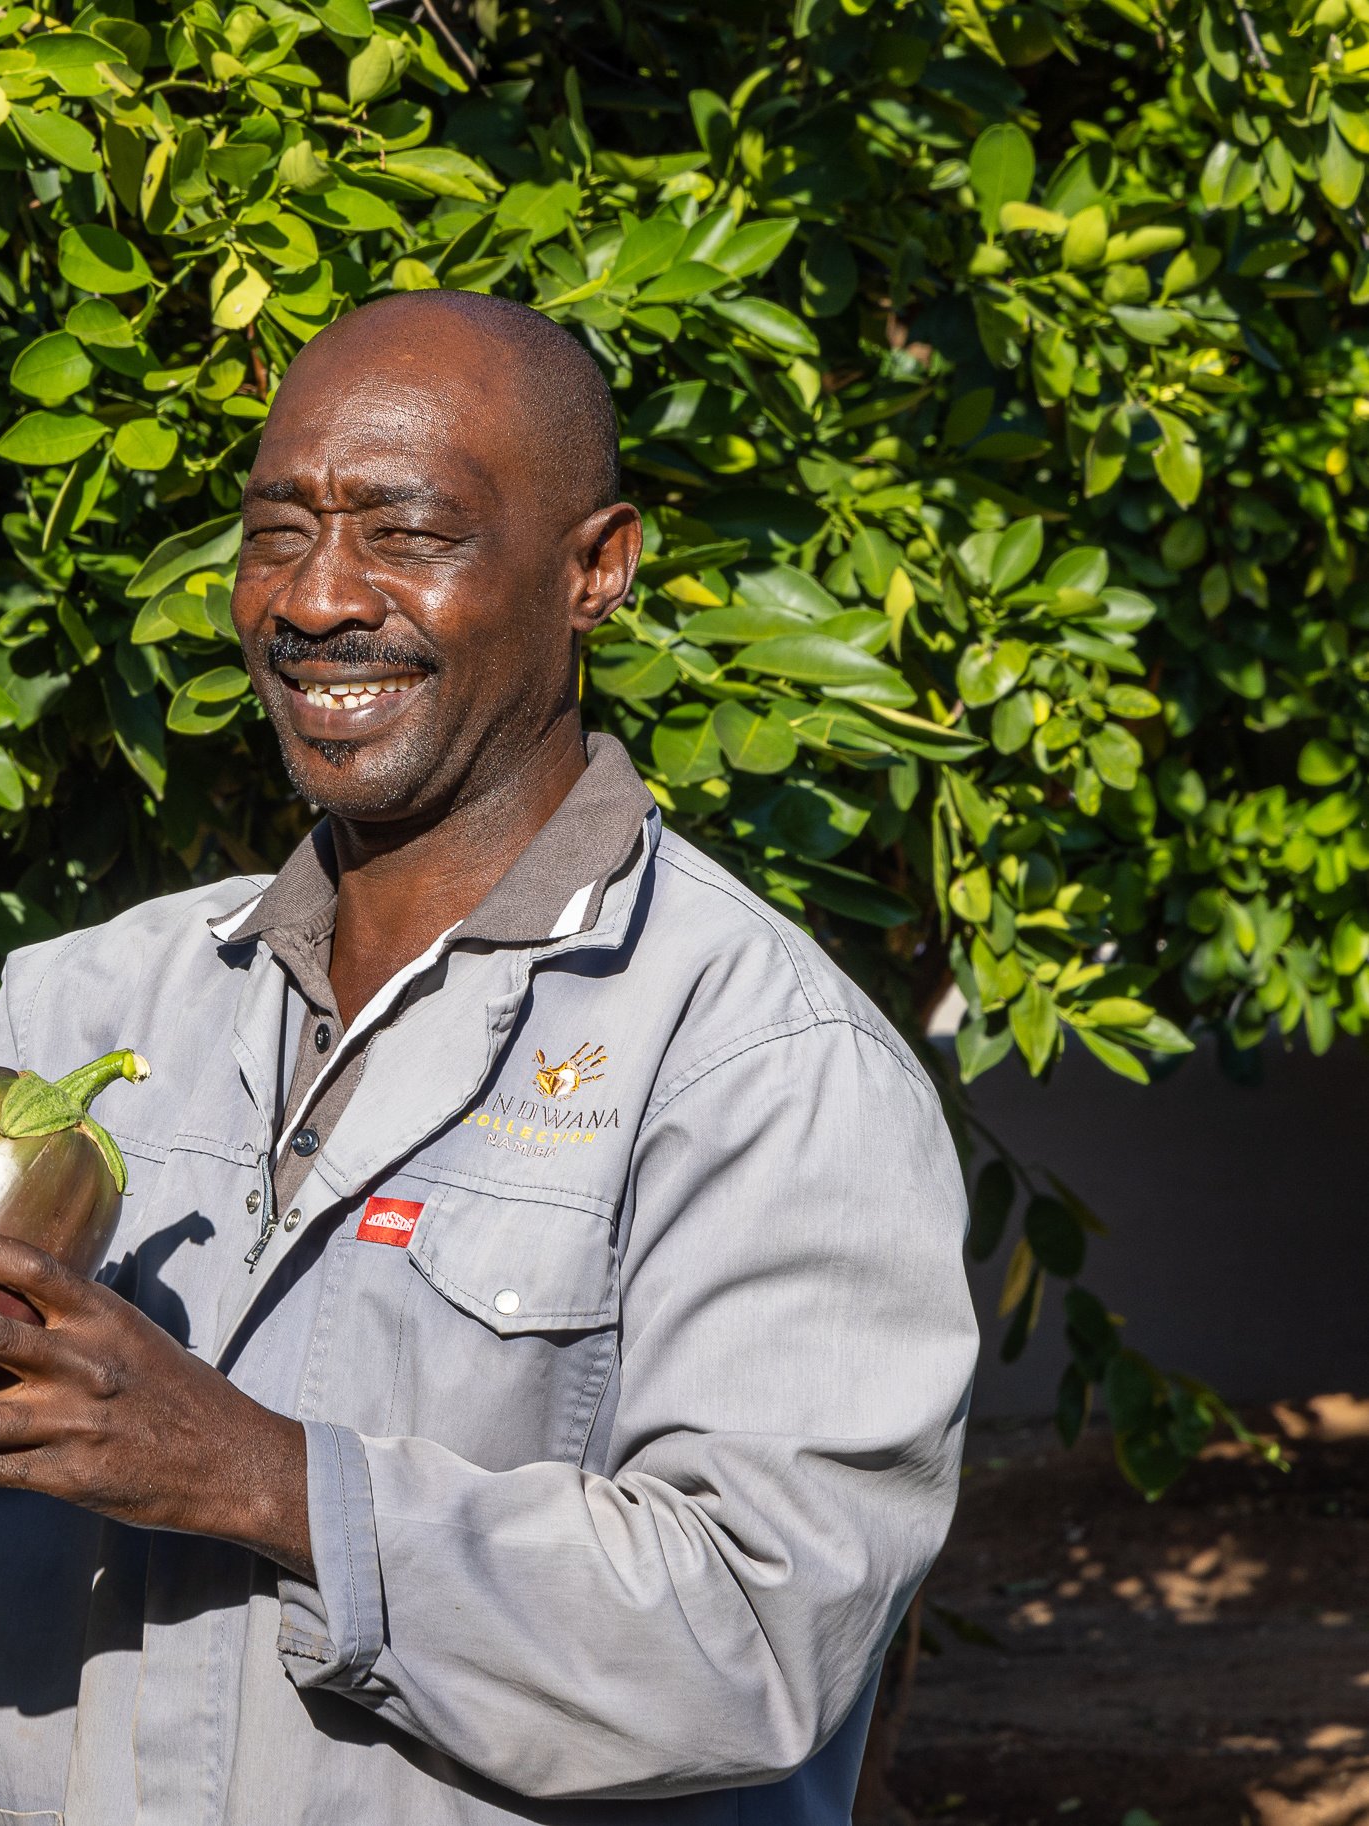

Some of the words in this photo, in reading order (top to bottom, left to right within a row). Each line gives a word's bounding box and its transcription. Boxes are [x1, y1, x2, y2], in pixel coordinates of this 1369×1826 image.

[462, 1112, 597, 1144] COLLECTION
[485, 1132, 560, 1158] NAMIBIA
[365, 1211, 413, 1232] JONSSON
